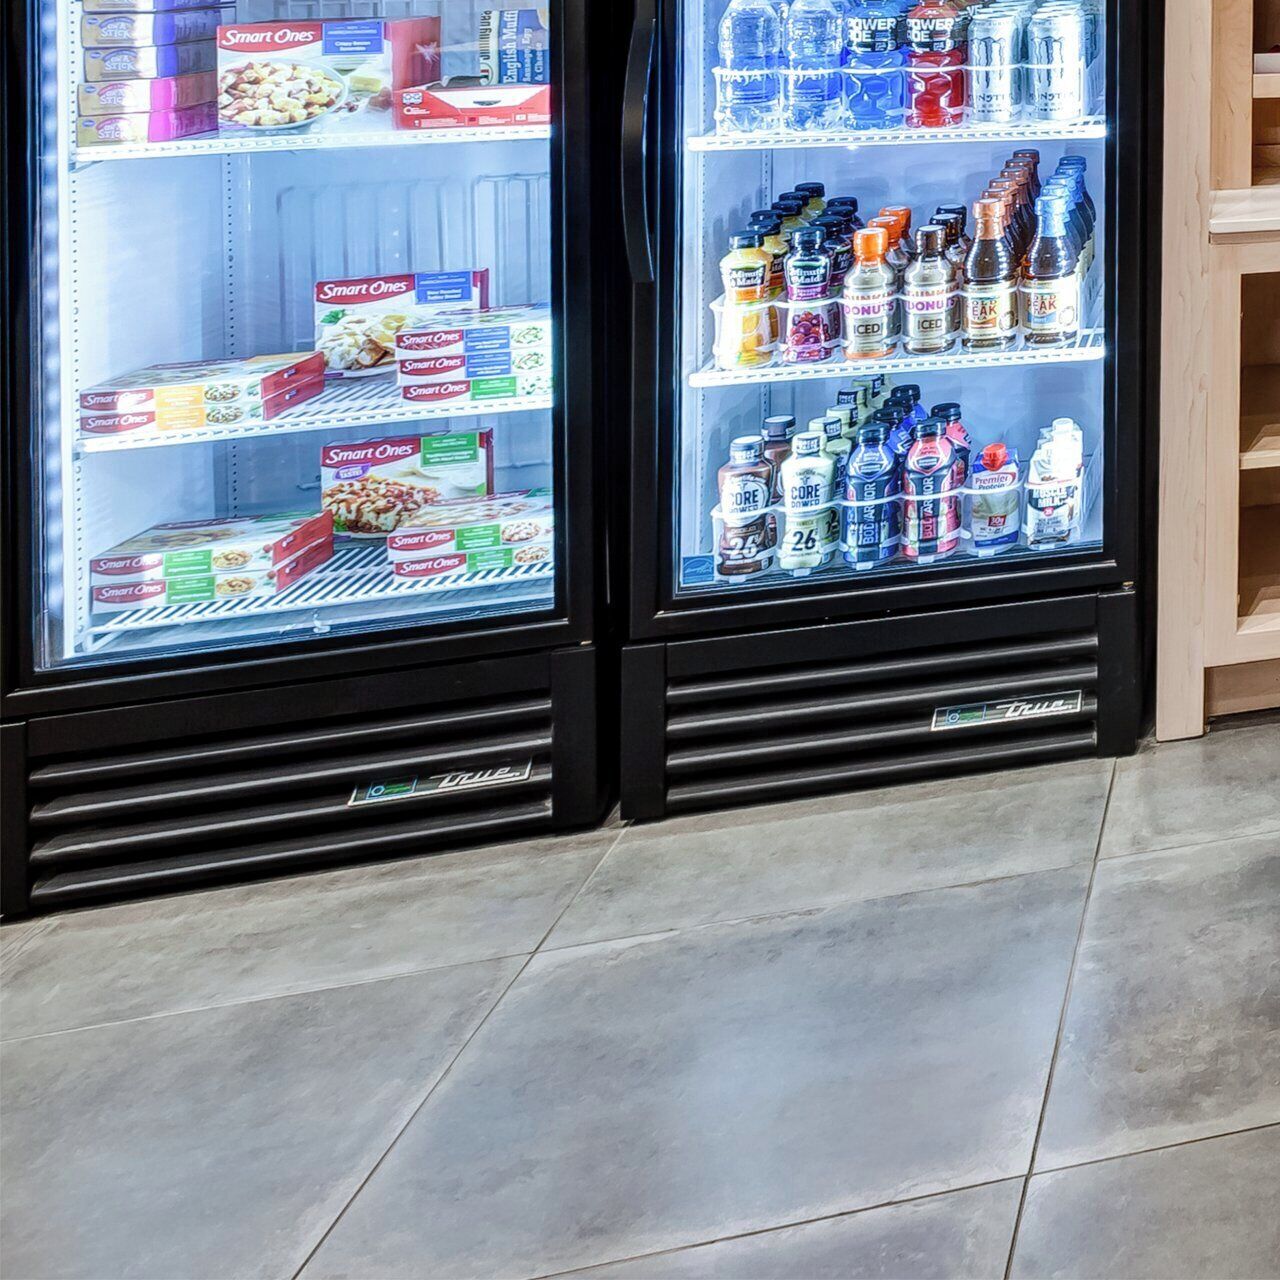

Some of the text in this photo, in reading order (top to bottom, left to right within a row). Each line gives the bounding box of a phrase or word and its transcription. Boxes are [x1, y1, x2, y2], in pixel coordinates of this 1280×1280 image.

[222, 29, 273, 45] Smart
[274, 28, 315, 44] Ones
[521, 27, 533, 45] Egg
[502, 10, 522, 83] English Muffi
[319, 281, 367, 300] Smart
[369, 280, 408, 295] Ones
[853, 323, 881, 335] ICED
[917, 319, 943, 330] ICED
[402, 332, 461, 346] Smart Ones
[402, 357, 463, 372] Smart Ones
[406, 383, 468, 398] Smart Ones
[83, 394, 119, 406] Smart
[86, 414, 149, 429] Smart Ones
[325, 448, 374, 465] Smart
[375, 444, 414, 459] Ones
[975, 474, 1009, 484] Premier
[791, 484, 820, 501] CORE
[393, 531, 452, 547] Smart Ones
[792, 529, 816, 552] 26
[97, 558, 130, 571] Smart
[400, 556, 461, 574] Smart Ones
[99, 583, 163, 599] Smart Ones
